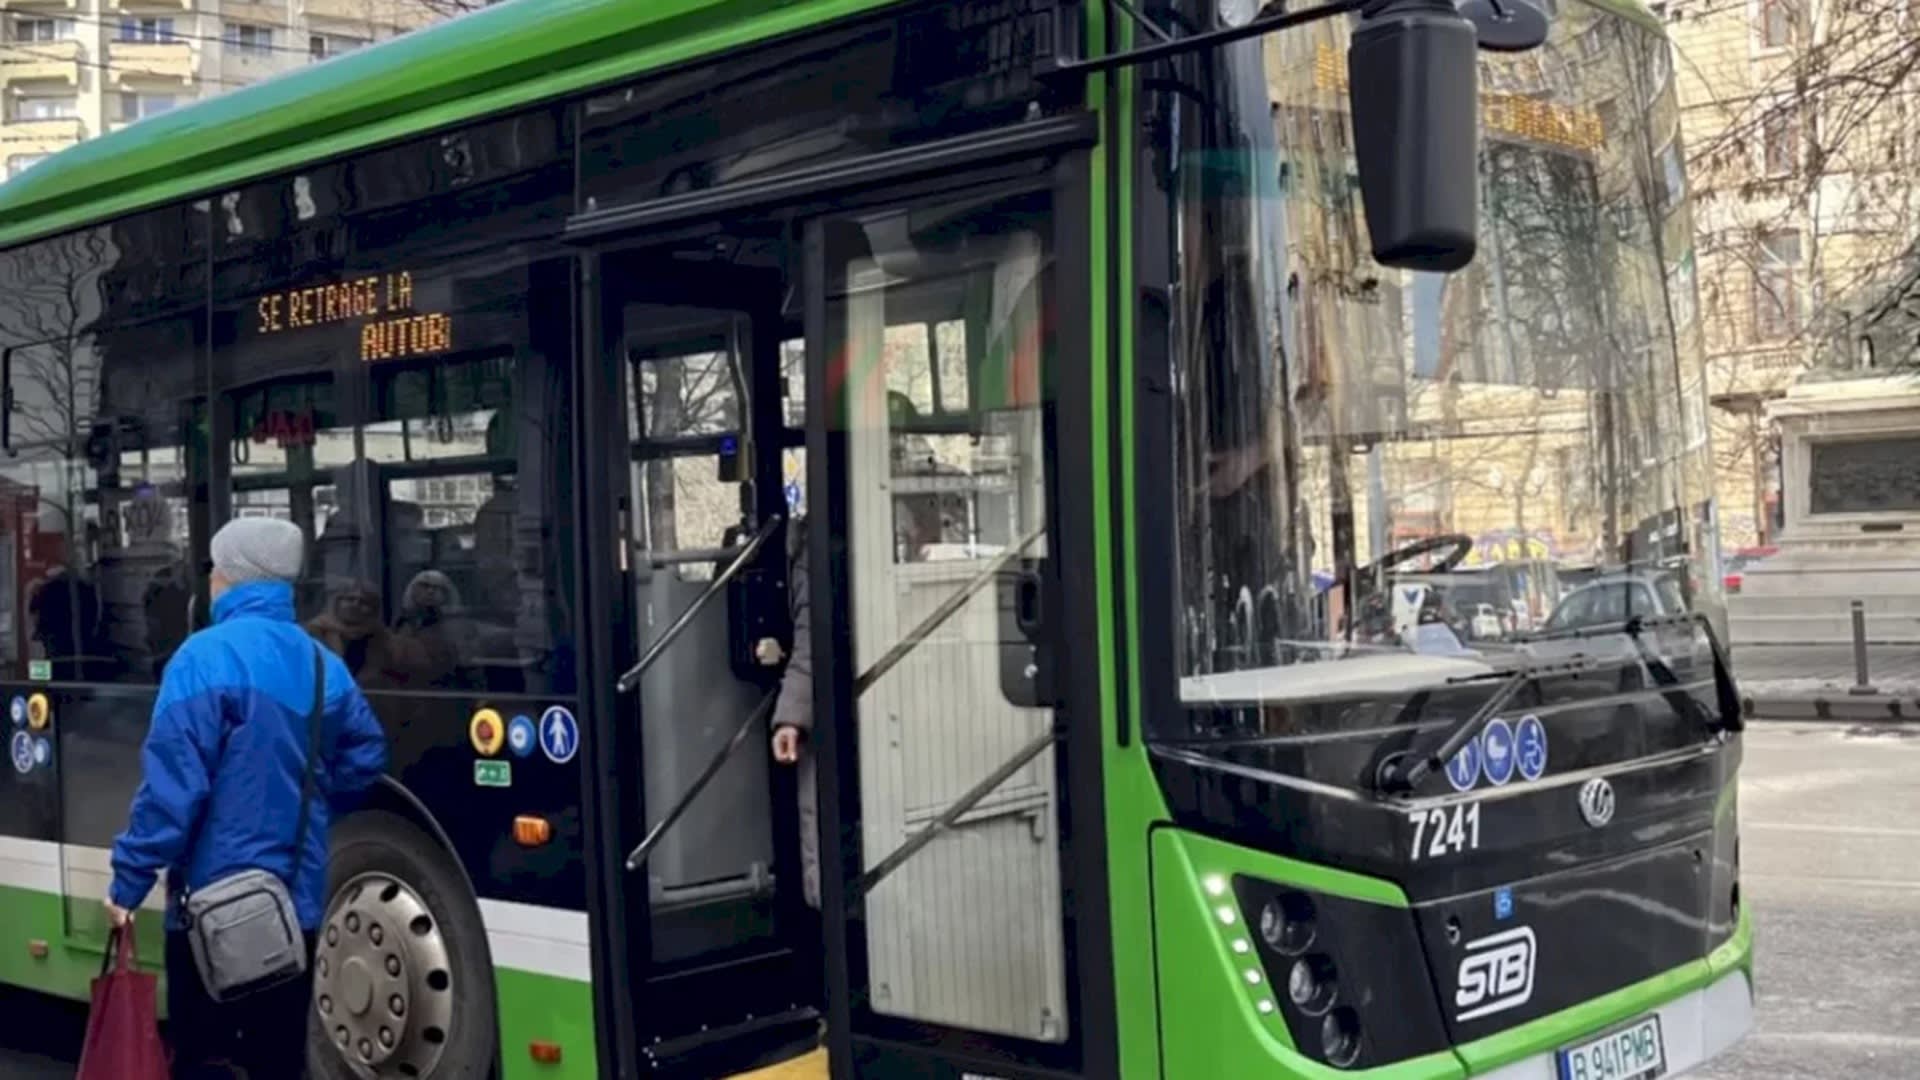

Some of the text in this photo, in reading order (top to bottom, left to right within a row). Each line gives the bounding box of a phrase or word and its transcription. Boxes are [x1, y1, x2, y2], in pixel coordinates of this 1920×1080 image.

[257, 270, 413, 333] SE RETRAGE LA
[1408, 802, 1480, 861] 7241
[1456, 938, 1530, 1008] STB
